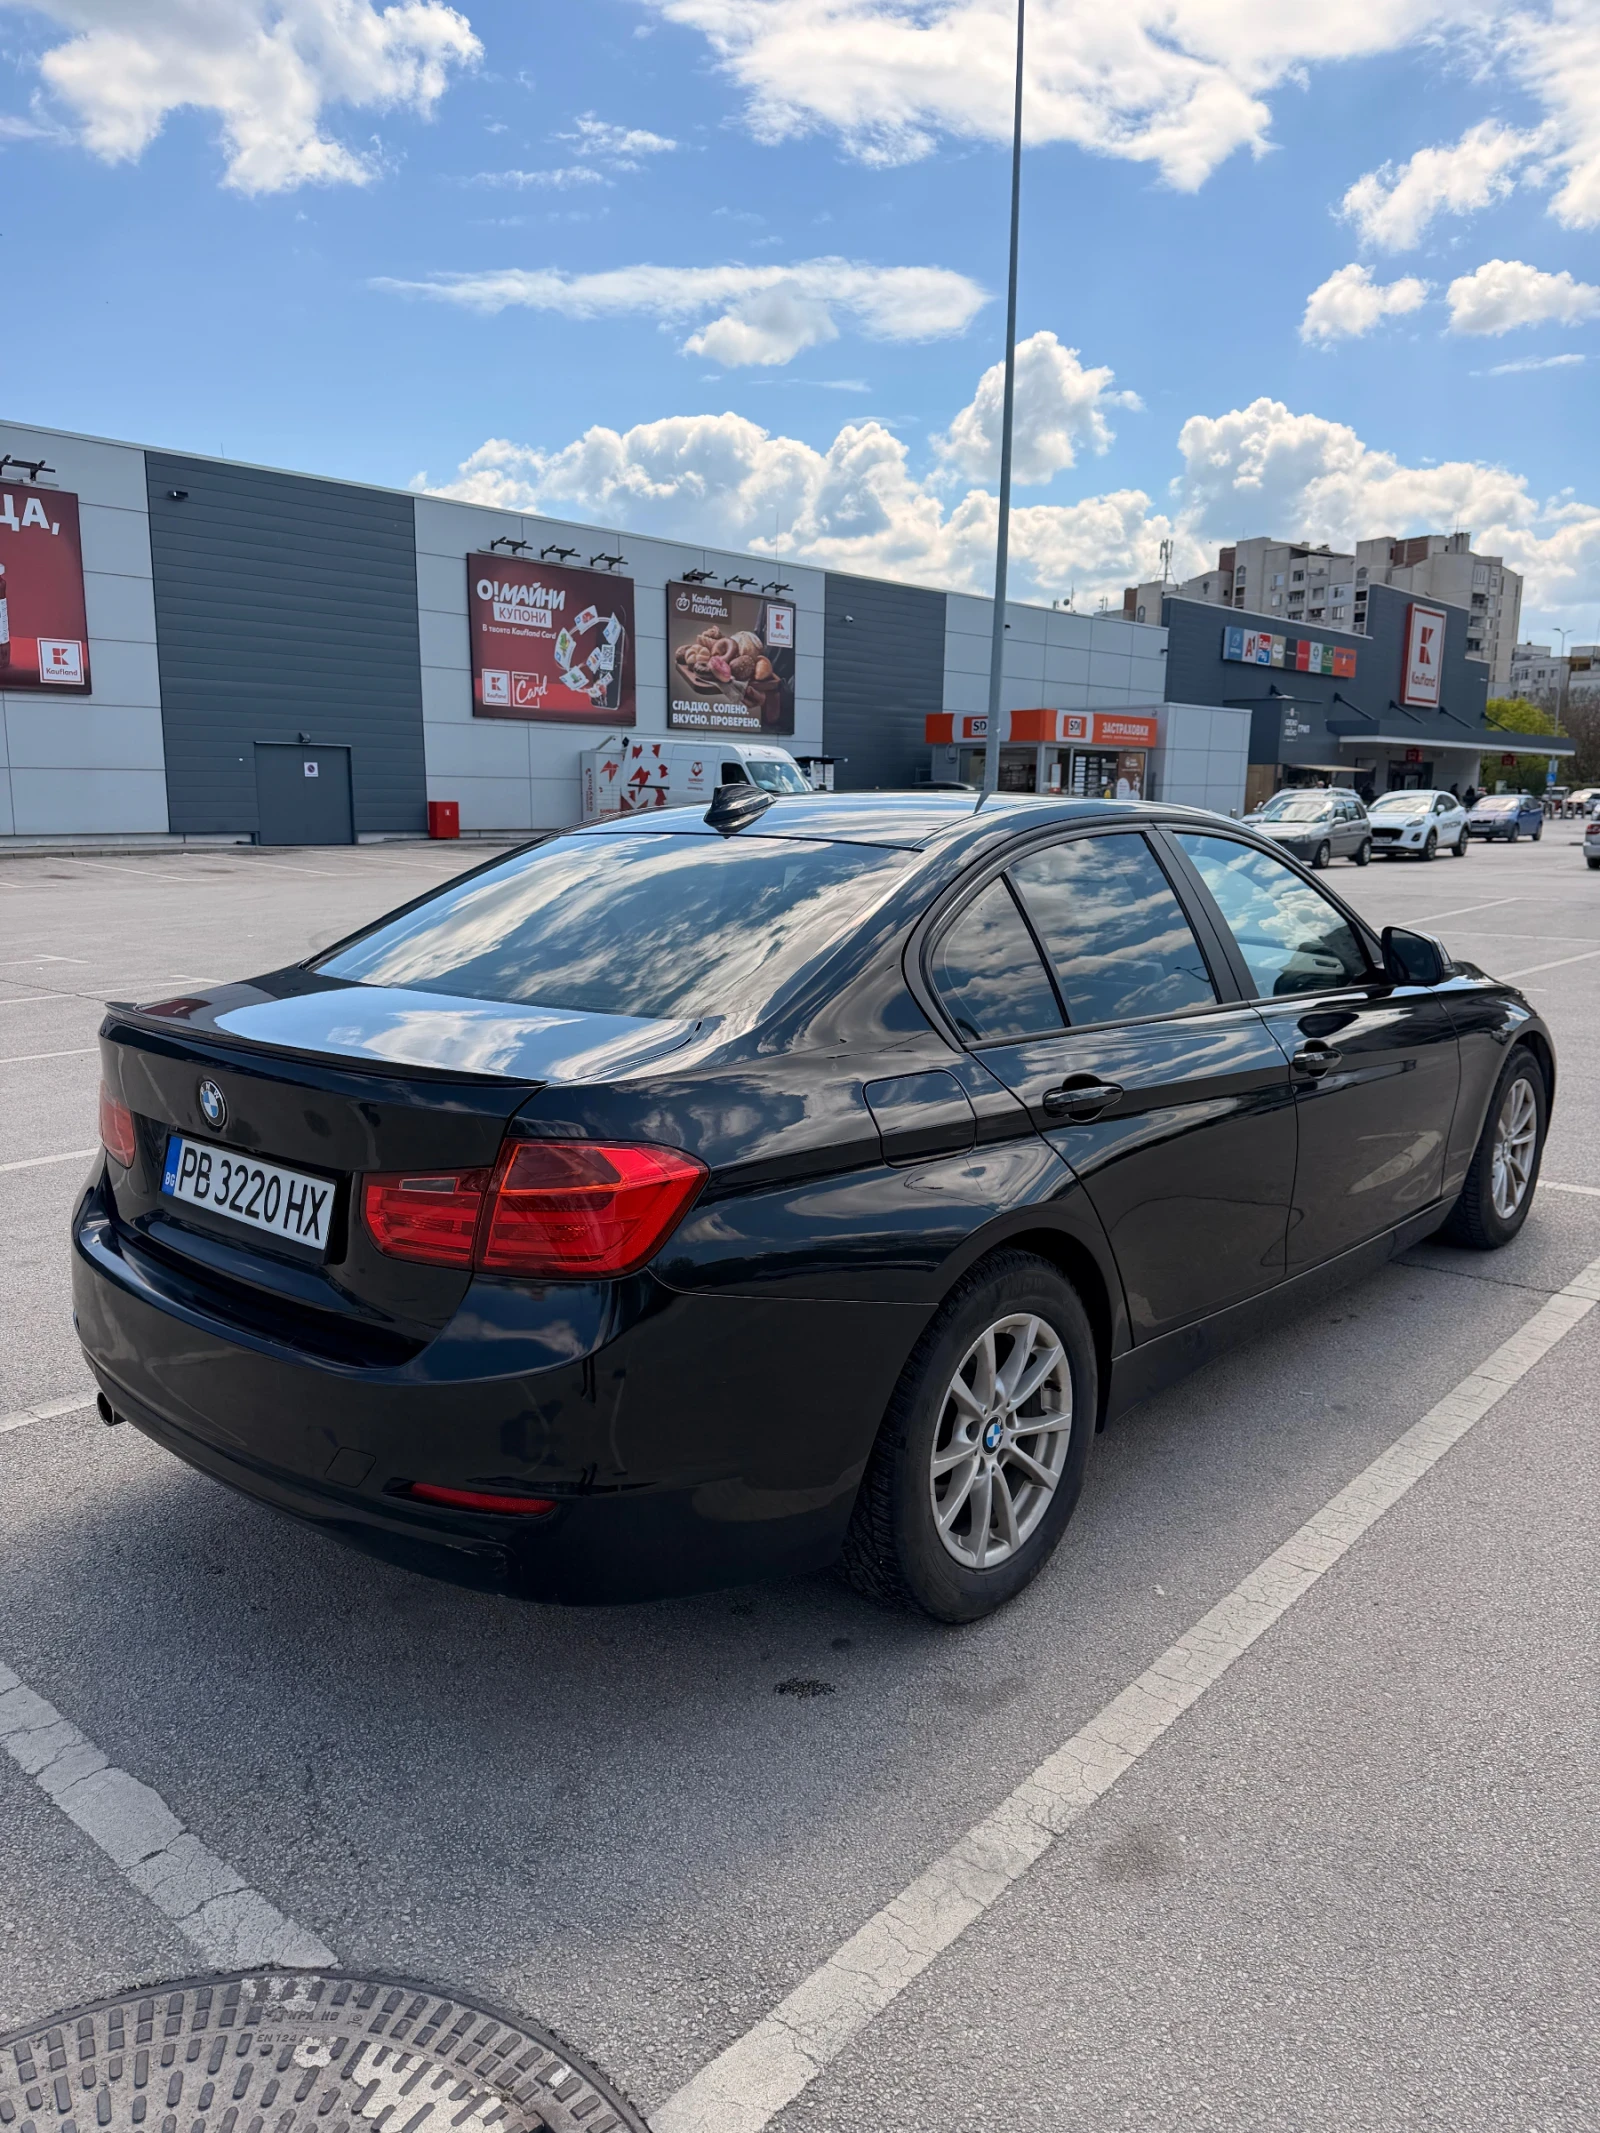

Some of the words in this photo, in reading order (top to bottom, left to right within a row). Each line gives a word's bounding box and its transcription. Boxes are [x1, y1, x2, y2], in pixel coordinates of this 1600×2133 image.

[692, 593, 723, 607] Kaufland
[498, 607, 547, 625] КУПОНИ
[691, 605, 729, 618] пекарна
[482, 623, 488, 632] В
[489, 626, 511, 636] твоята
[511, 627, 541, 638] Kaufland
[541, 630, 557, 640] Card
[770, 631, 790, 641] Kaufland
[46, 666, 78, 677] Kaufland
[1411, 671, 1437, 689] Kaufland
[487, 692, 508, 700] Kaufland
[515, 675, 549, 704] Card
[672, 700, 711, 714] СЛАДКО.
[713, 703, 750, 715] СОЛЕНО.
[672, 713, 709, 726] ВКУСНО.
[711, 717, 761, 728] ПРОВЕРЕНО.
[973, 720, 987, 732] SD
[1102, 721, 1149, 736] ЗАСТРАХОВКИ
[164, 1171, 176, 1187] BG
[214, 1159, 281, 1223] 3220
[283, 1180, 328, 1241] HX
[256, 2034, 273, 2043] EN
[276, 2034, 297, 2043] 124
